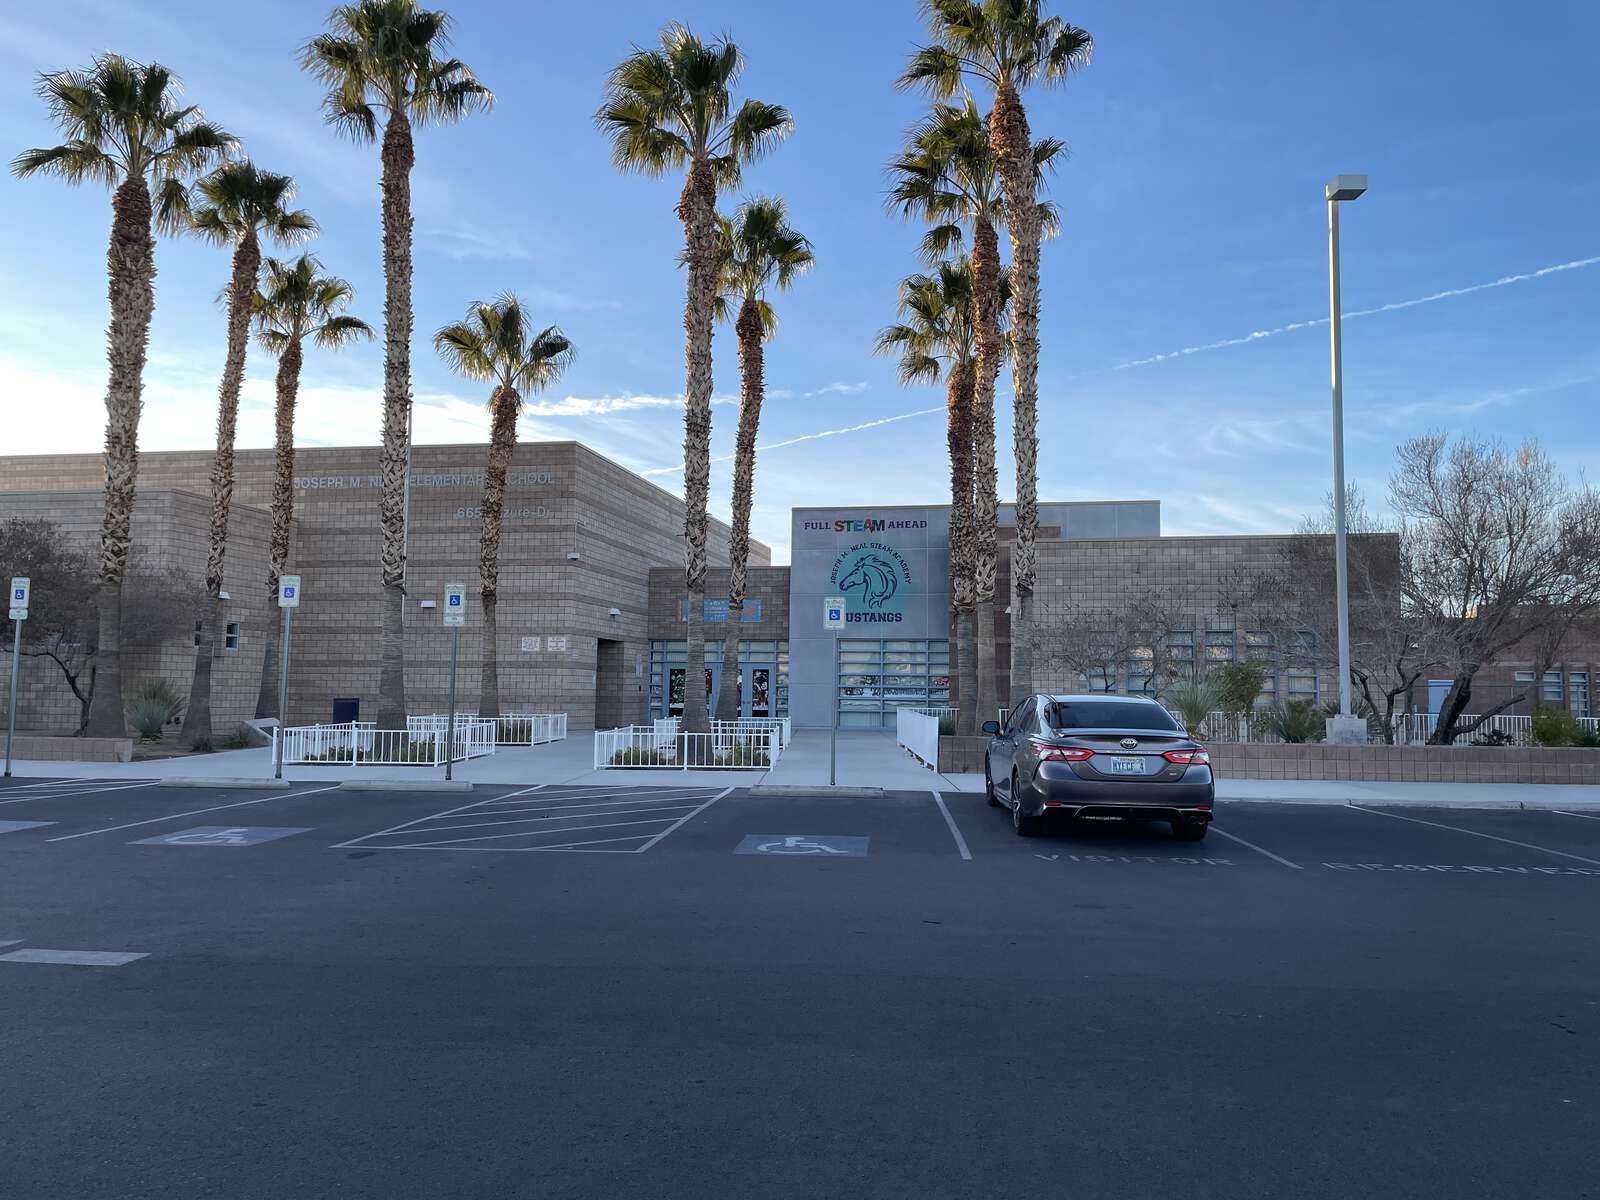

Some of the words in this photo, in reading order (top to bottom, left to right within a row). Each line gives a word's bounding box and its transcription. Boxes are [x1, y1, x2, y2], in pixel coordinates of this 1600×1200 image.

[294, 476, 344, 490] JOSEPH
[409, 473, 487, 487] ELEMENTAR
[505, 471, 554, 486] CHOOL
[456, 506, 482, 520] 665
[501, 507, 530, 519] zure
[803, 521, 831, 530] FULL
[833, 516, 885, 533] STEAM
[887, 520, 928, 529] AHEAD
[830, 559, 844, 585] JOSEPH
[849, 542, 869, 553] NEAL
[869, 542, 894, 554] STEAM
[892, 551, 912, 585] ACADEMY
[845, 612, 903, 623] USTANGS
